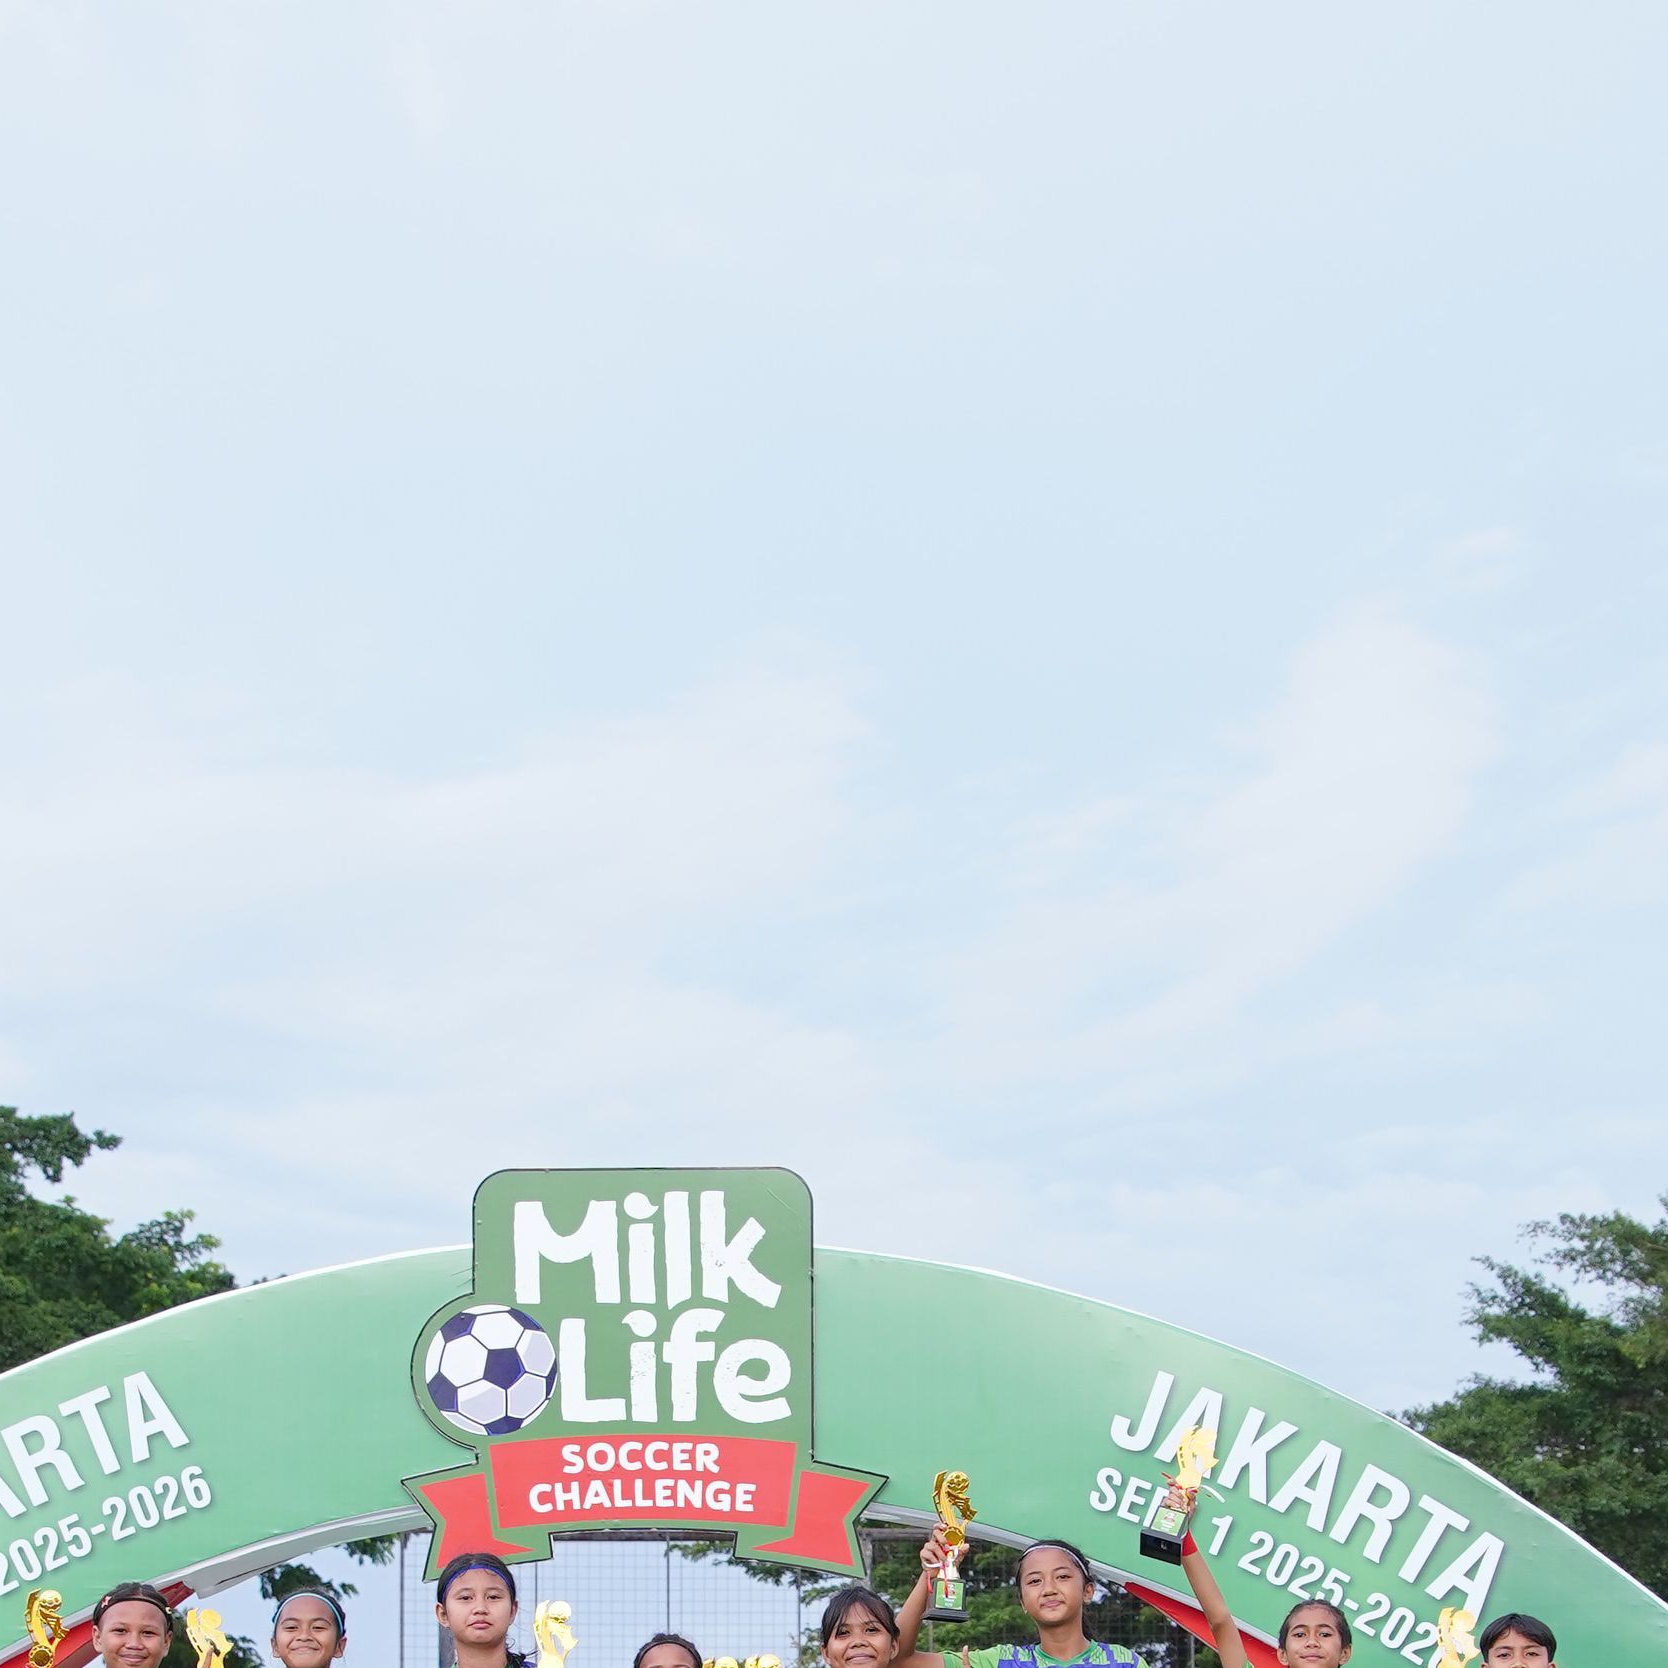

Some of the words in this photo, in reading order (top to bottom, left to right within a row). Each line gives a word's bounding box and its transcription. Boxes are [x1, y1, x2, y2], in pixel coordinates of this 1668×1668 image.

[513, 1190, 782, 1309] Milk
[559, 1308, 793, 1423] Life
[528, 1479, 756, 1513] CHALLENGE
[562, 1442, 720, 1474] SOCCER
[1110, 1370, 1505, 1626] JAKARTA
[1089, 1467, 1172, 1529] SE
[1208, 1515, 1233, 1556] 1
